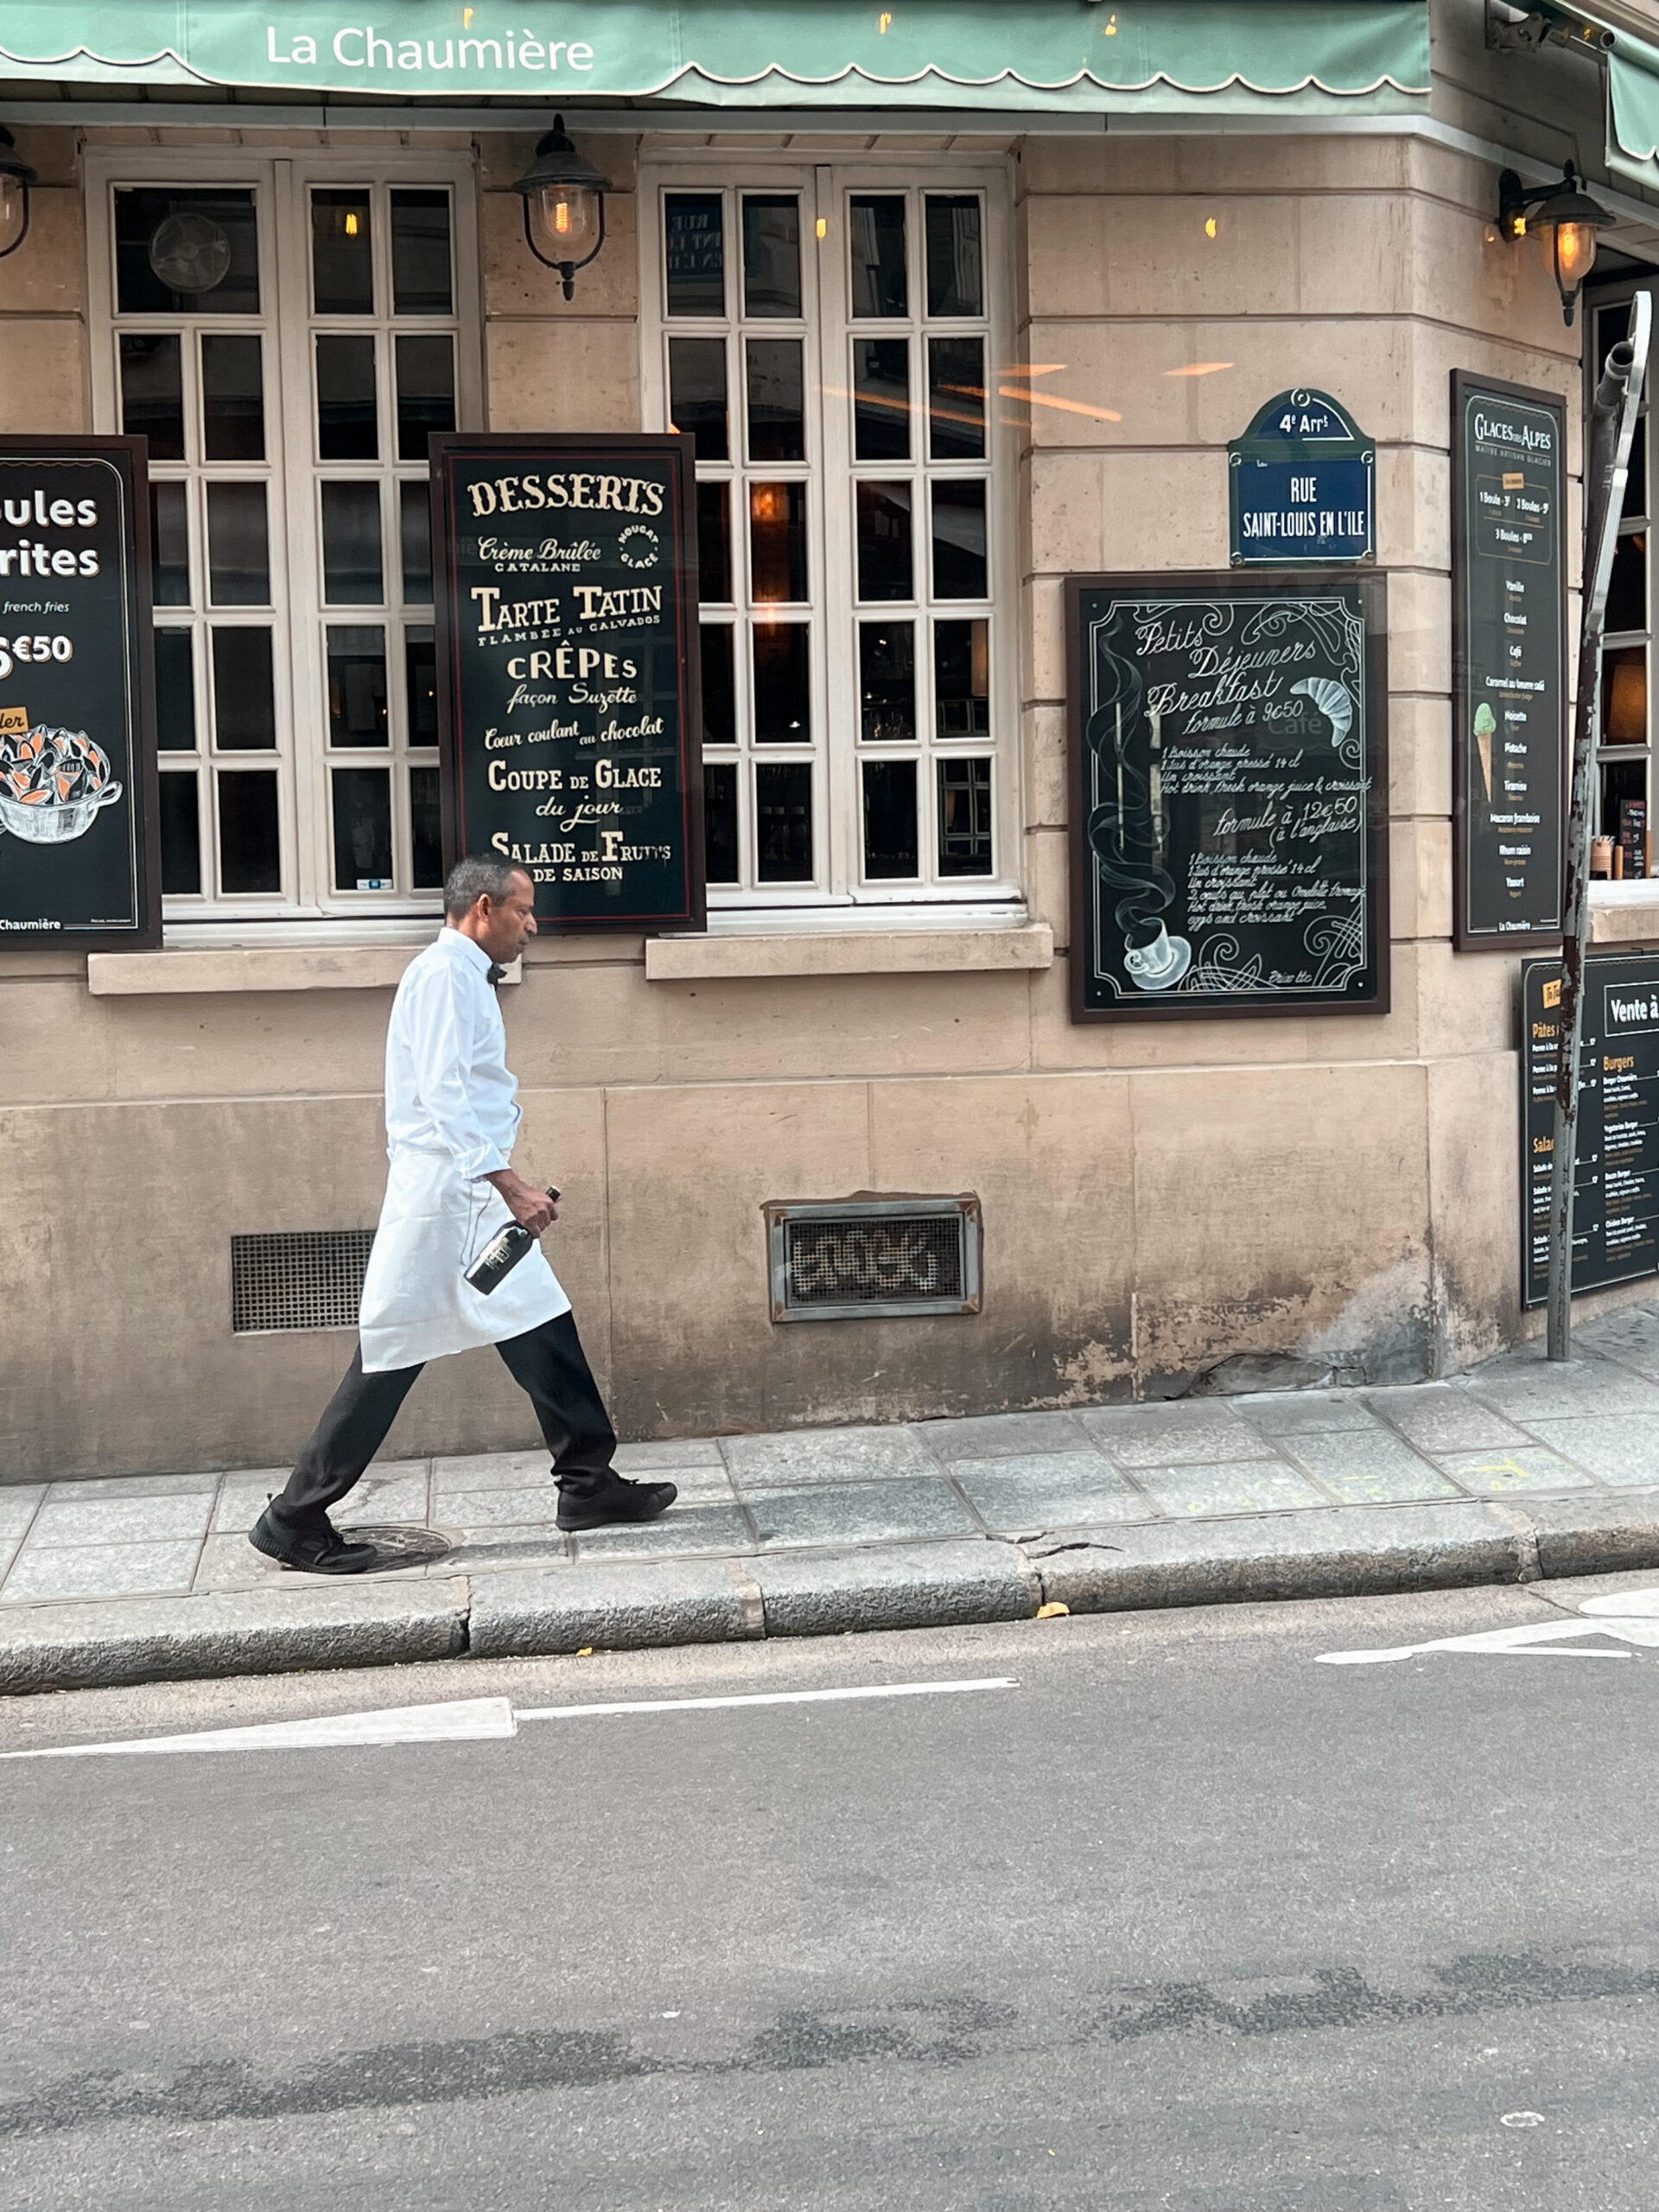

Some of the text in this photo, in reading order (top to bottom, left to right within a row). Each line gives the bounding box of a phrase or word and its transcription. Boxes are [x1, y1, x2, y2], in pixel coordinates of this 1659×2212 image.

[268, 27, 594, 70] La Chaumière
[1475, 413, 1513, 441] GLACES
[1522, 425, 1551, 451] ALPES
[467, 474, 666, 517] DESSERTS
[1291, 477, 1317, 503] RUE
[0, 490, 98, 527] ules
[1243, 511, 1364, 537] SAINT-LOUIS EN L'ILE
[478, 537, 533, 560] Crème
[537, 537, 601, 560] Brûlée
[618, 524, 659, 543] NOUGAT
[494, 563, 581, 573] CATALANE
[620, 553, 659, 569] GLACE
[3, 601, 70, 614] french fries
[471, 586, 663, 632] TARTE TATIN
[568, 626, 583, 635] AU
[589, 615, 660, 632] CALVADOS
[1135, 620, 1204, 656] Petits
[507, 639, 638, 679] CRÊPES
[1187, 640, 1316, 683] Déjeuners
[506, 682, 638, 714] façon Suzette
[1144, 670, 1284, 717] Breakfast
[528, 719, 580, 743] coulant
[579, 736, 596, 746] au
[601, 715, 664, 742] chocolat
[1181, 702, 1243, 734] formule
[1244, 705, 1257, 724] à
[1167, 745, 1211, 759] Boisson
[1215, 742, 1250, 758] chaude
[488, 759, 661, 791] COUPE DE GLACE
[536, 795, 624, 833] du jour
[1212, 796, 1357, 836] formule à 12€50
[491, 832, 575, 863] SALADE
[582, 850, 599, 861] DE
[1239, 848, 1277, 863] chaude
[533, 867, 623, 882] DE SAISON
[1611, 999, 1648, 1023] Vente
[1532, 1021, 1555, 1038] Pâtes
[1603, 1056, 1635, 1072] Burgers
